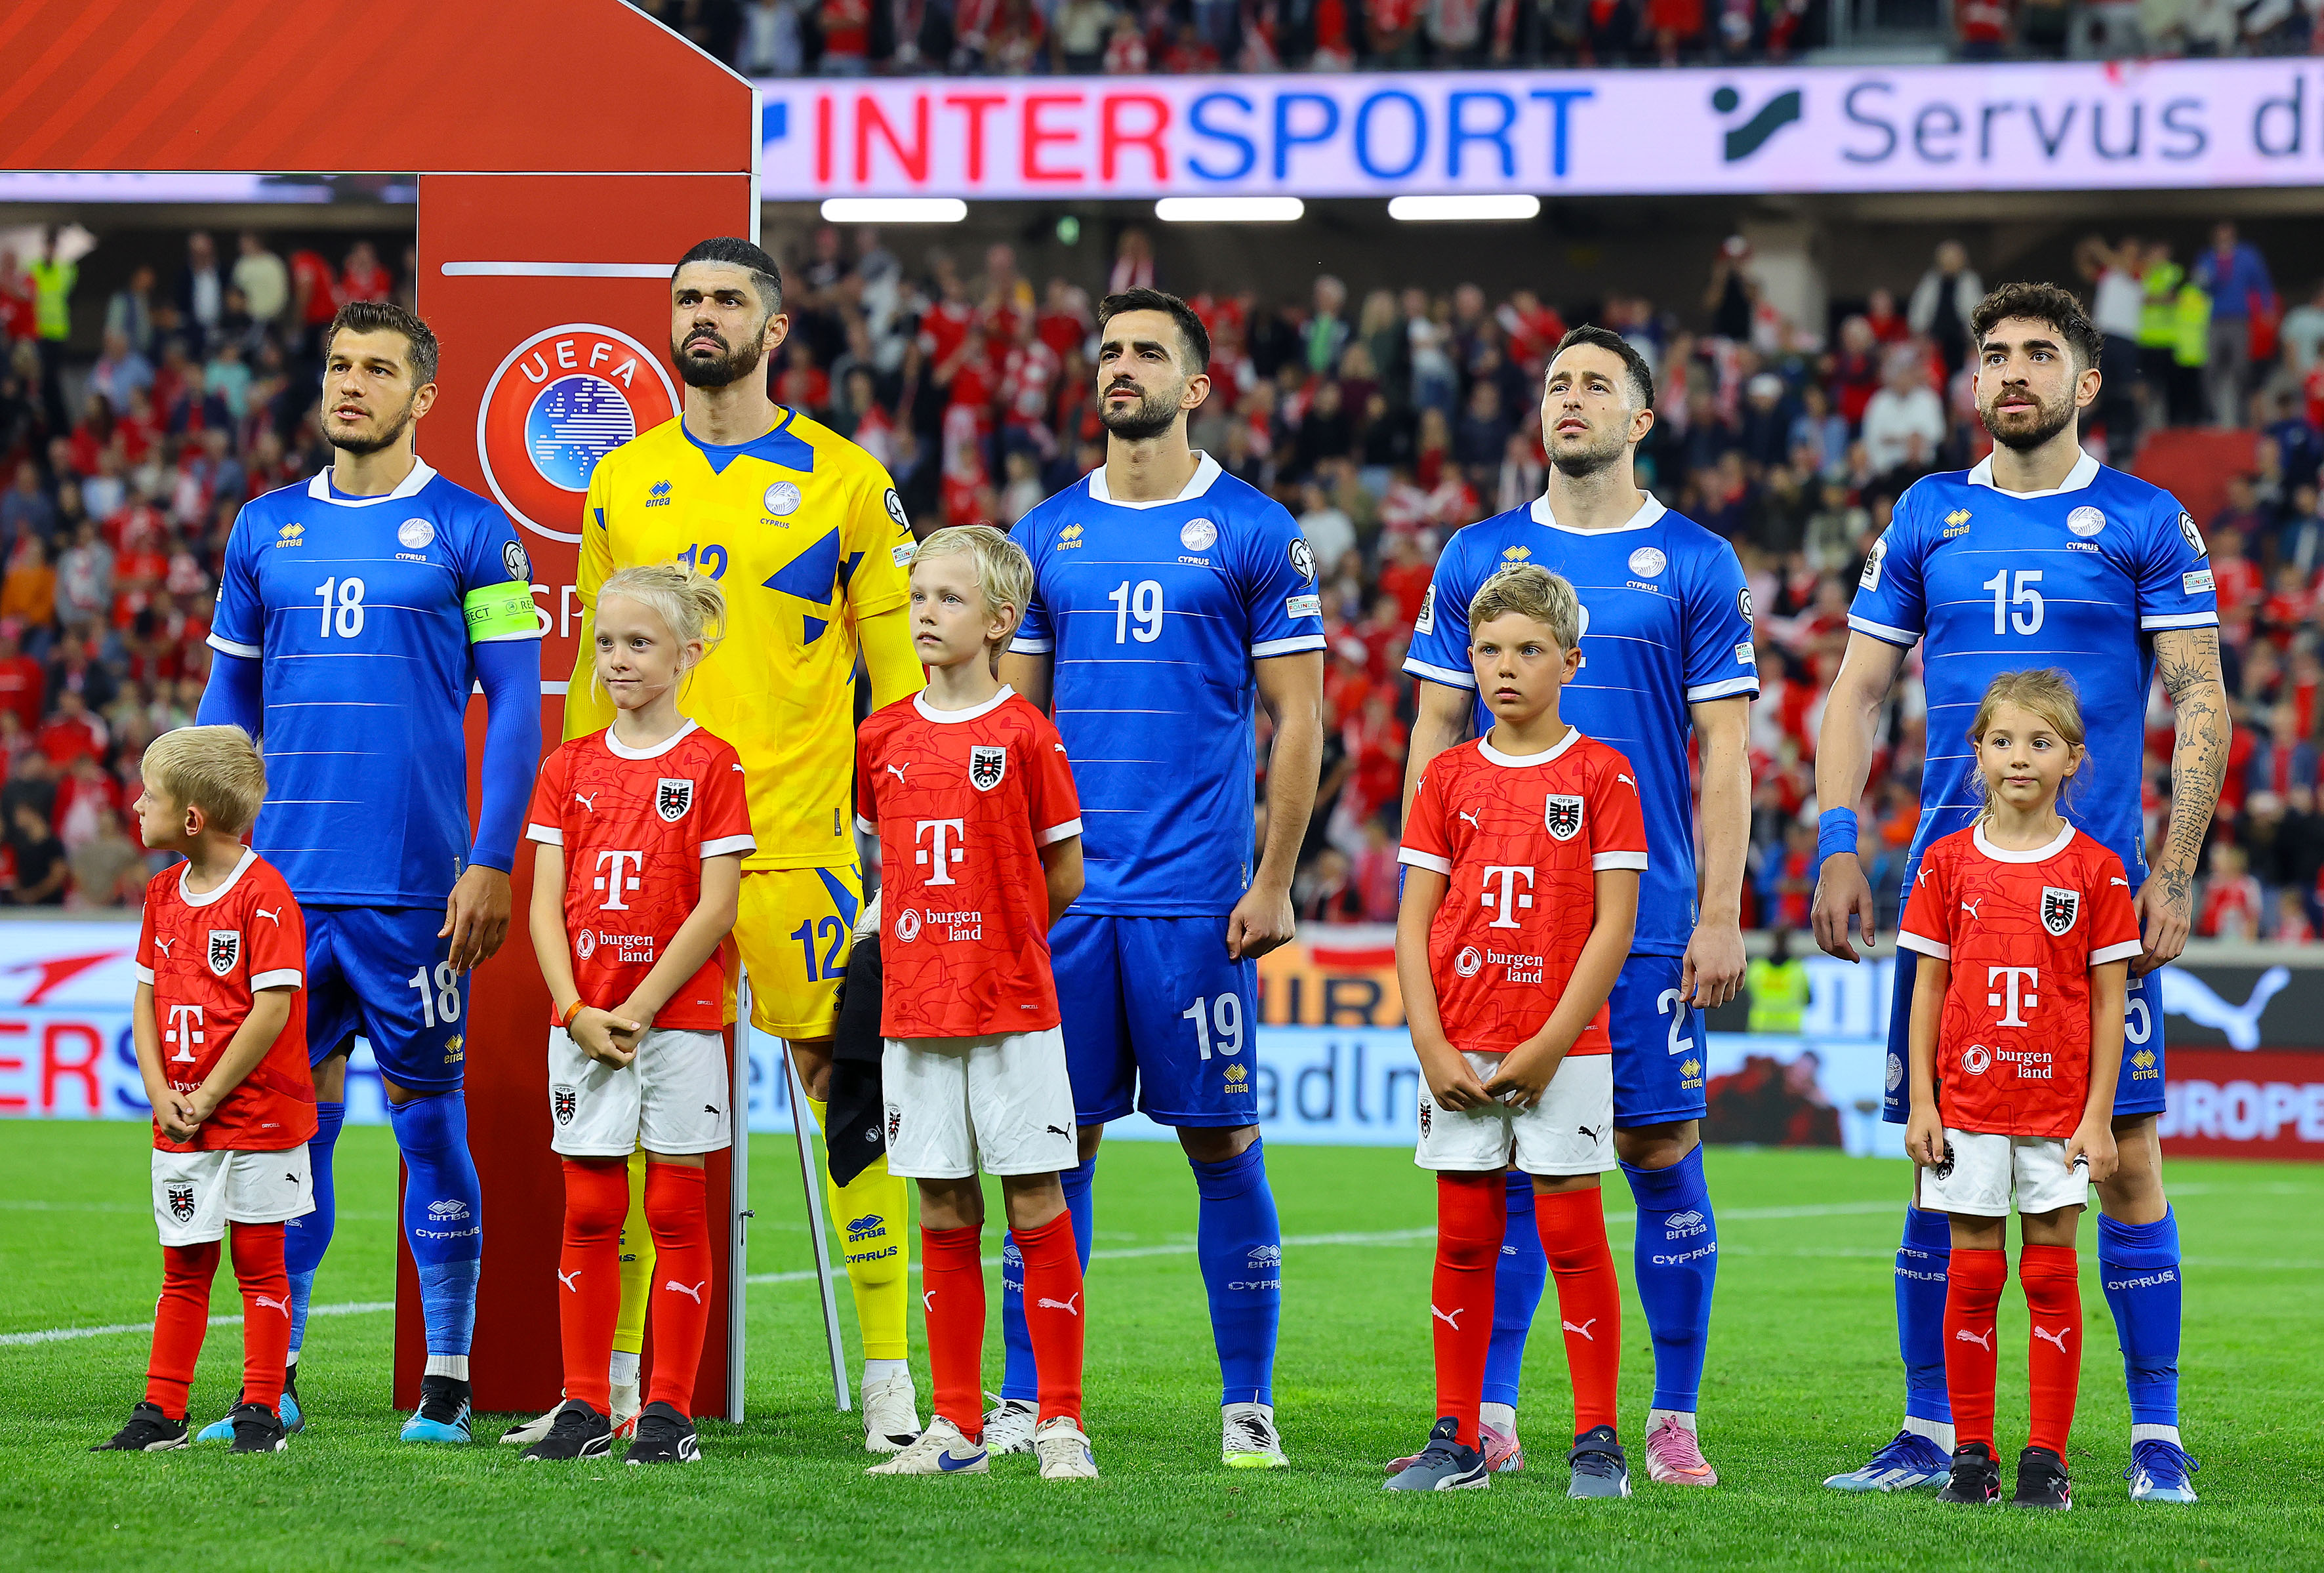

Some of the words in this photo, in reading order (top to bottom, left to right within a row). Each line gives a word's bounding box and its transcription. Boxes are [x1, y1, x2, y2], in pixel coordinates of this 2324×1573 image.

[1843, 80, 2209, 166] Servus
[815, 88, 1595, 185] INTERSPORT
[520, 338, 638, 390] UEFA
[645, 497, 670, 508] errea
[760, 518, 790, 529] CYPRUS
[1943, 524, 1970, 538] errea
[276, 538, 303, 548] errea
[1057, 539, 1082, 550] errea
[2066, 542, 2099, 552] CYPRUS
[395, 552, 427, 562] CYPRUS
[1178, 556, 1210, 566] CYPRUS
[1626, 580, 1658, 592] CYPRUS
[315, 577, 365, 638] 18
[1983, 569, 2045, 636] 15
[466, 607, 489, 623] PECT
[1109, 580, 1164, 644] 19
[916, 818, 964, 886] T
[594, 851, 643, 910] T
[1481, 866, 1534, 928] T
[926, 908, 982, 926] burgen
[600, 930, 655, 950] burgen
[948, 925, 982, 941] land
[619, 947, 654, 963] land
[790, 916, 847, 983] 12
[1486, 949, 1543, 968] burgen
[1506, 968, 1543, 983] land
[409, 960, 461, 1029] 18
[1988, 966, 2038, 1027] T
[2125, 978, 2151, 1045] 5
[1183, 992, 1244, 1061] 19
[1657, 988, 1694, 1056] 2
[165, 1005, 204, 1063] T
[444, 1052, 463, 1064] errea
[1996, 1046, 2052, 1063] burgen
[2017, 1064, 2052, 1079] land
[2132, 1068, 2159, 1080] errea
[1224, 1083, 1248, 1093] errea
[1681, 1077, 1703, 1090] errea
[416, 1224, 480, 1240] CYPRUS
[846, 1245, 898, 1264] CYPRUS
[1652, 1241, 1717, 1264] CYPRUS
[2107, 1270, 2176, 1290] CYPRUS
